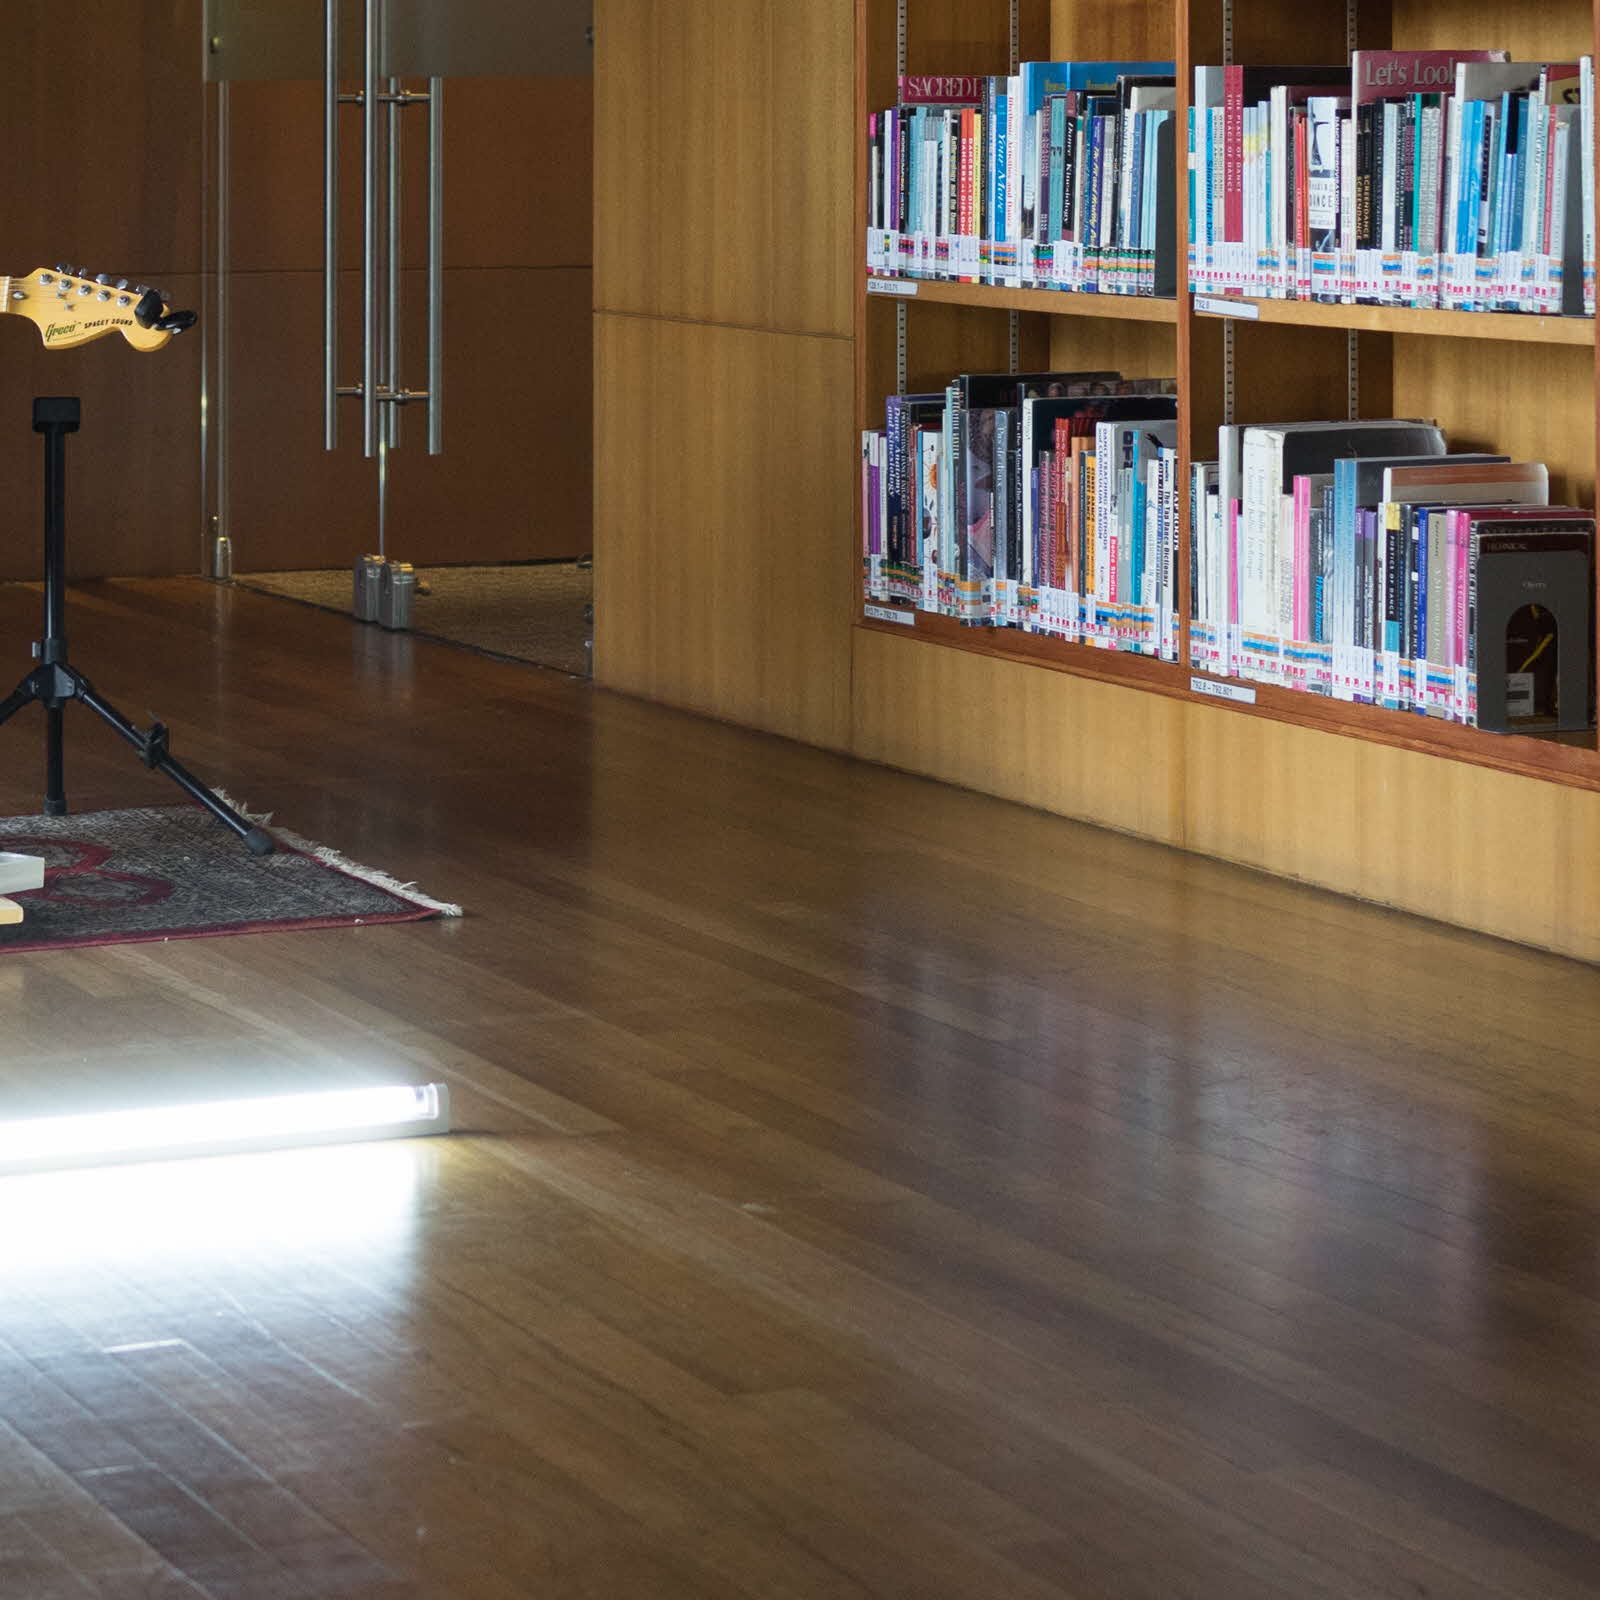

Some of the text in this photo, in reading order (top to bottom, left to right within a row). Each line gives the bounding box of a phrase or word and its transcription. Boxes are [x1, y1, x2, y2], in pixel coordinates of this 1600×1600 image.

[1365, 60, 1408, 86] Let's
[908, 77, 973, 97] SACRED
[1227, 146, 1232, 159] OF
[1236, 146, 1241, 159] OF
[997, 133, 1006, 214] Your Move
[950, 184, 958, 197] and
[1063, 163, 1073, 224] Kinesiology
[1090, 176, 1100, 228] and Healthy
[45, 322, 76, 343] Greco
[111, 318, 134, 326] SOUND
[886, 406, 895, 498] and Kinesiology
[997, 426, 1006, 487] Pas de deux
[1016, 475, 1022, 484] of
[1163, 491, 1171, 588] The Tap Dance Dictionary
[1388, 573, 1395, 586] OF
